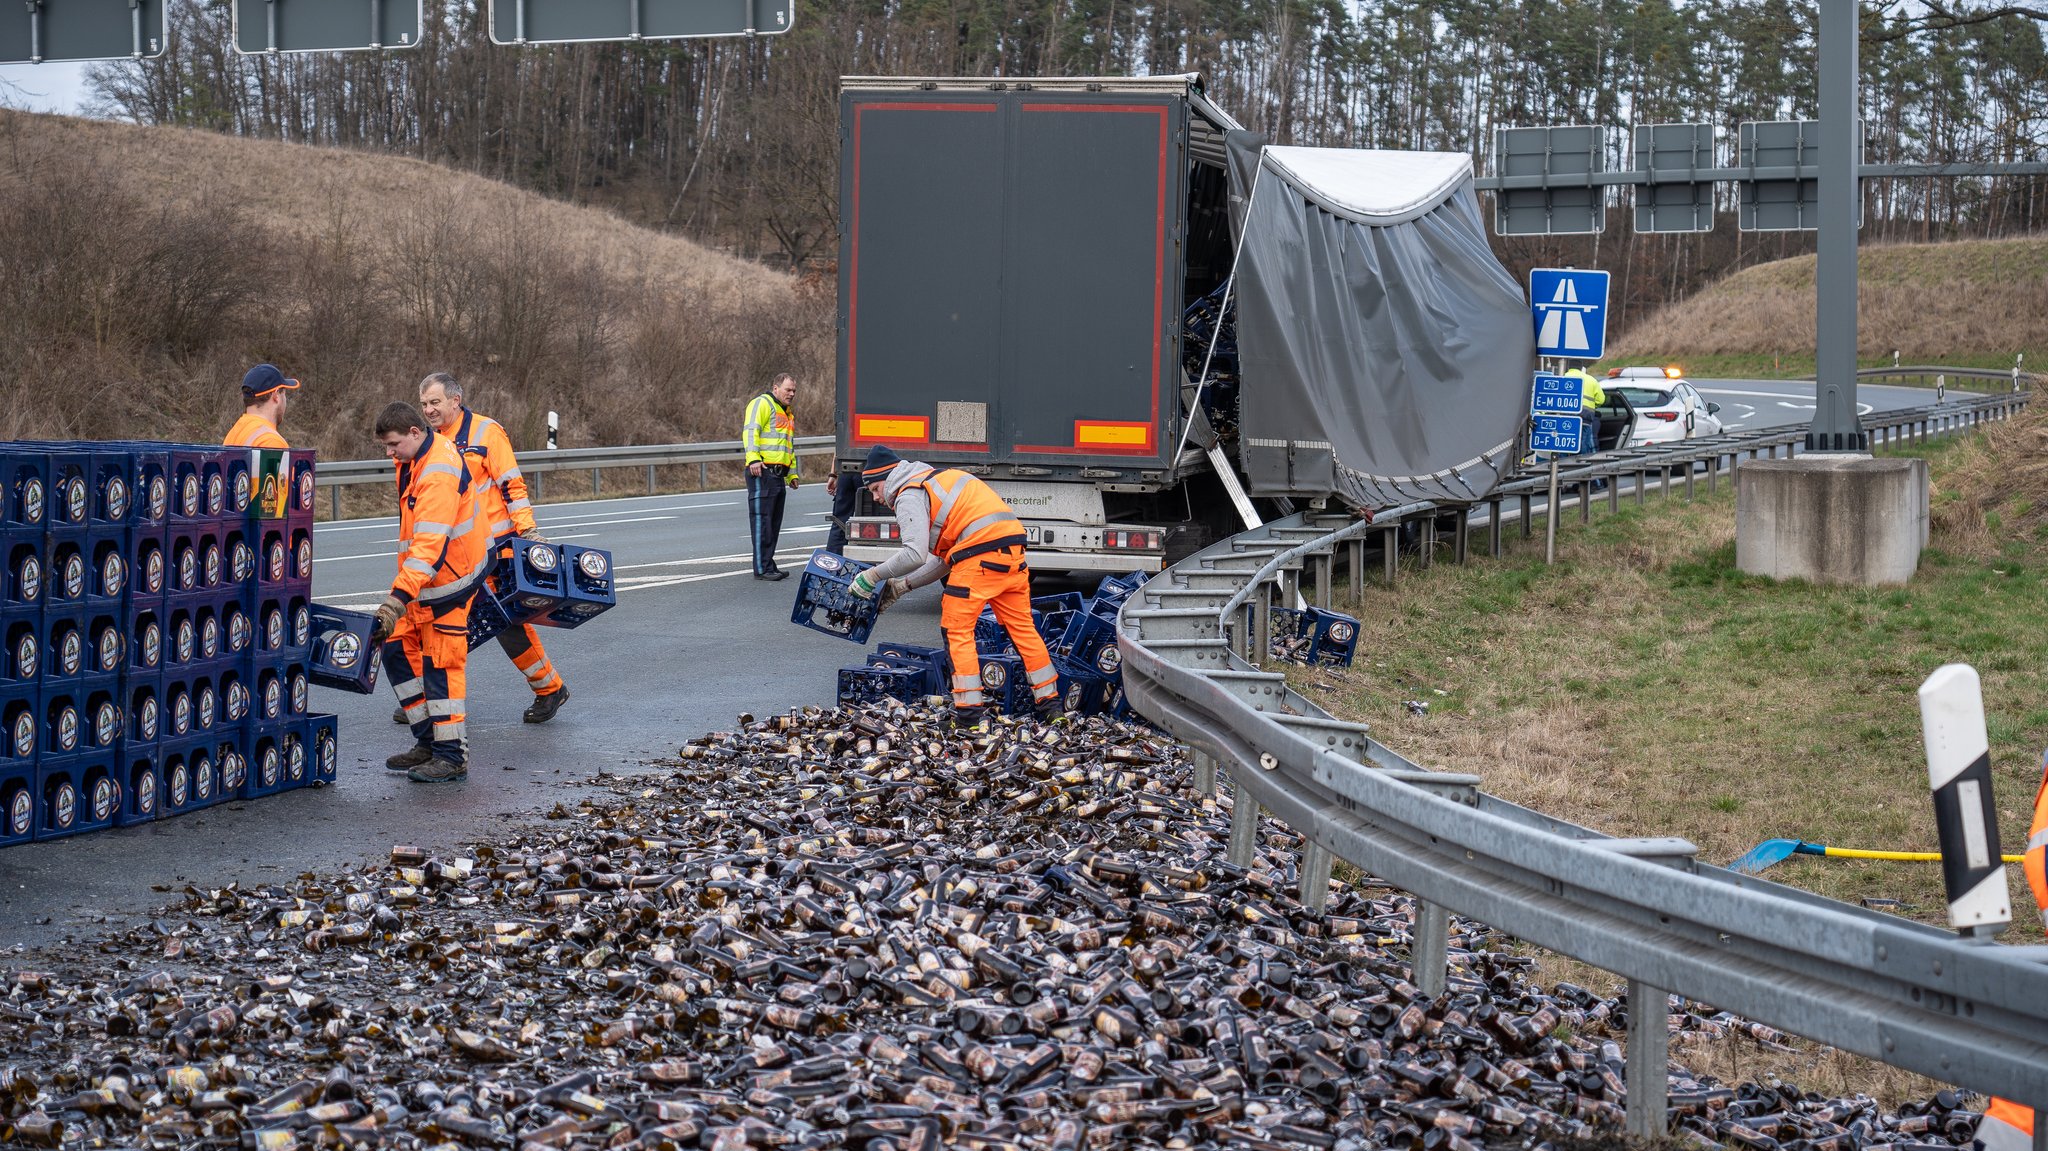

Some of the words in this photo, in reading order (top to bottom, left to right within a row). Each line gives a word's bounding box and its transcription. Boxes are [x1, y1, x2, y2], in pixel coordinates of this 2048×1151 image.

[1536, 397, 1554, 407] E-M
[1557, 398, 1579, 408] 0.040
[1534, 436, 1550, 447] D-F
[1554, 437, 1576, 448] 0.075
